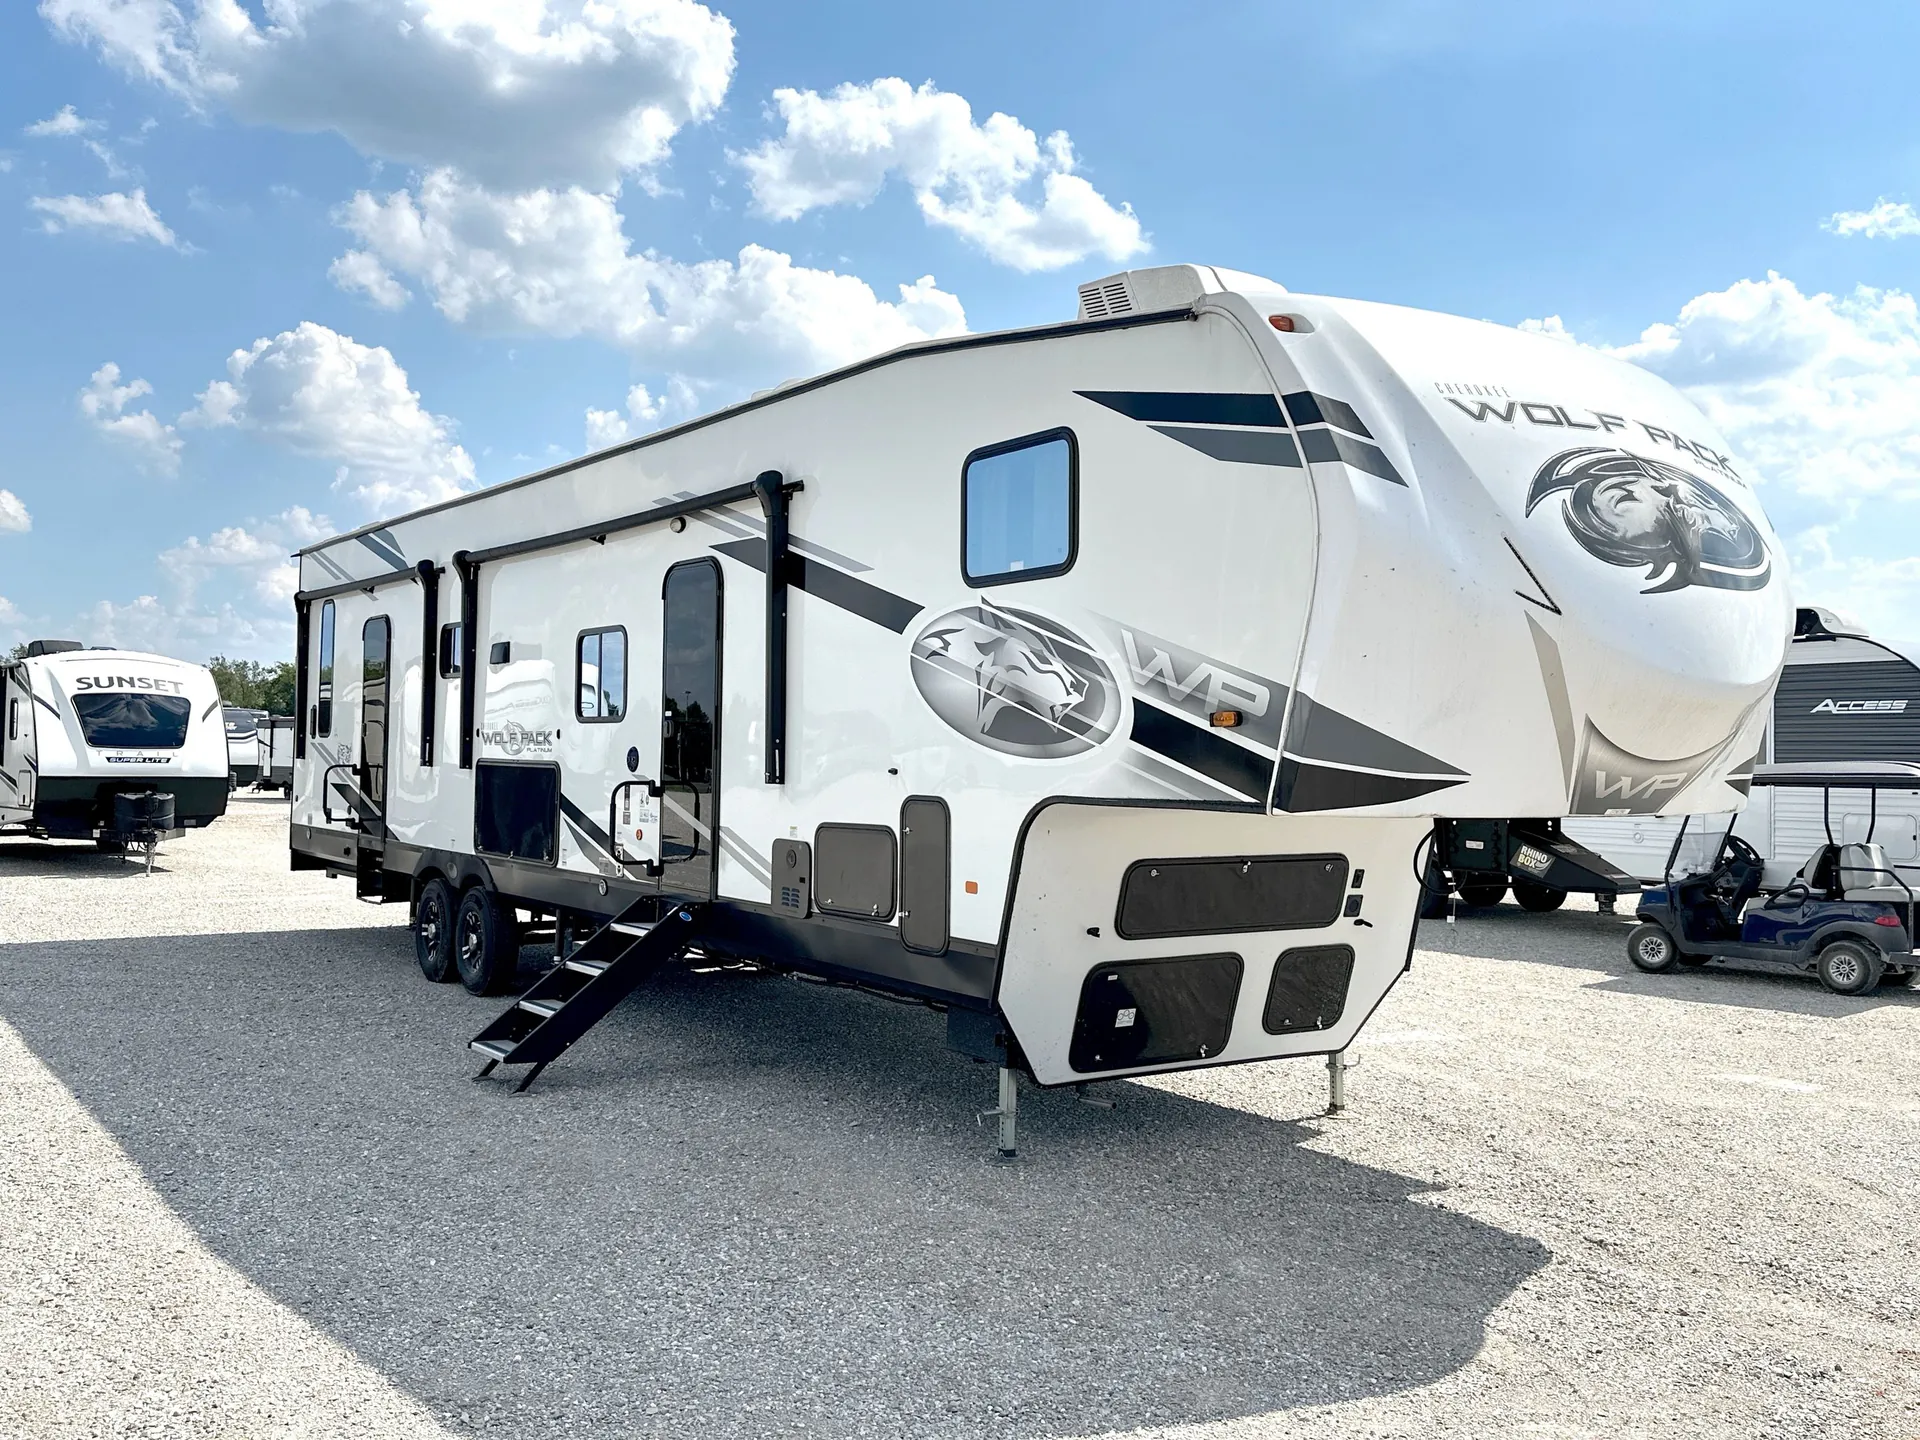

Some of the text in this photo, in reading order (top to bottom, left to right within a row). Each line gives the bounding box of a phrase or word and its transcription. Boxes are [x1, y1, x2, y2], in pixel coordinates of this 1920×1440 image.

[1434, 382, 1511, 398] CHEROKEE
[1443, 397, 1743, 480] WOLF PACK
[1121, 628, 1271, 717] WP
[75, 676, 184, 694] SUNSET
[1809, 698, 1909, 714] ACCESS
[481, 731, 553, 746] WOLF PACK
[1595, 770, 1688, 799] WP
[1517, 853, 1537, 868] BOX
[1520, 845, 1548, 863] RHINO
